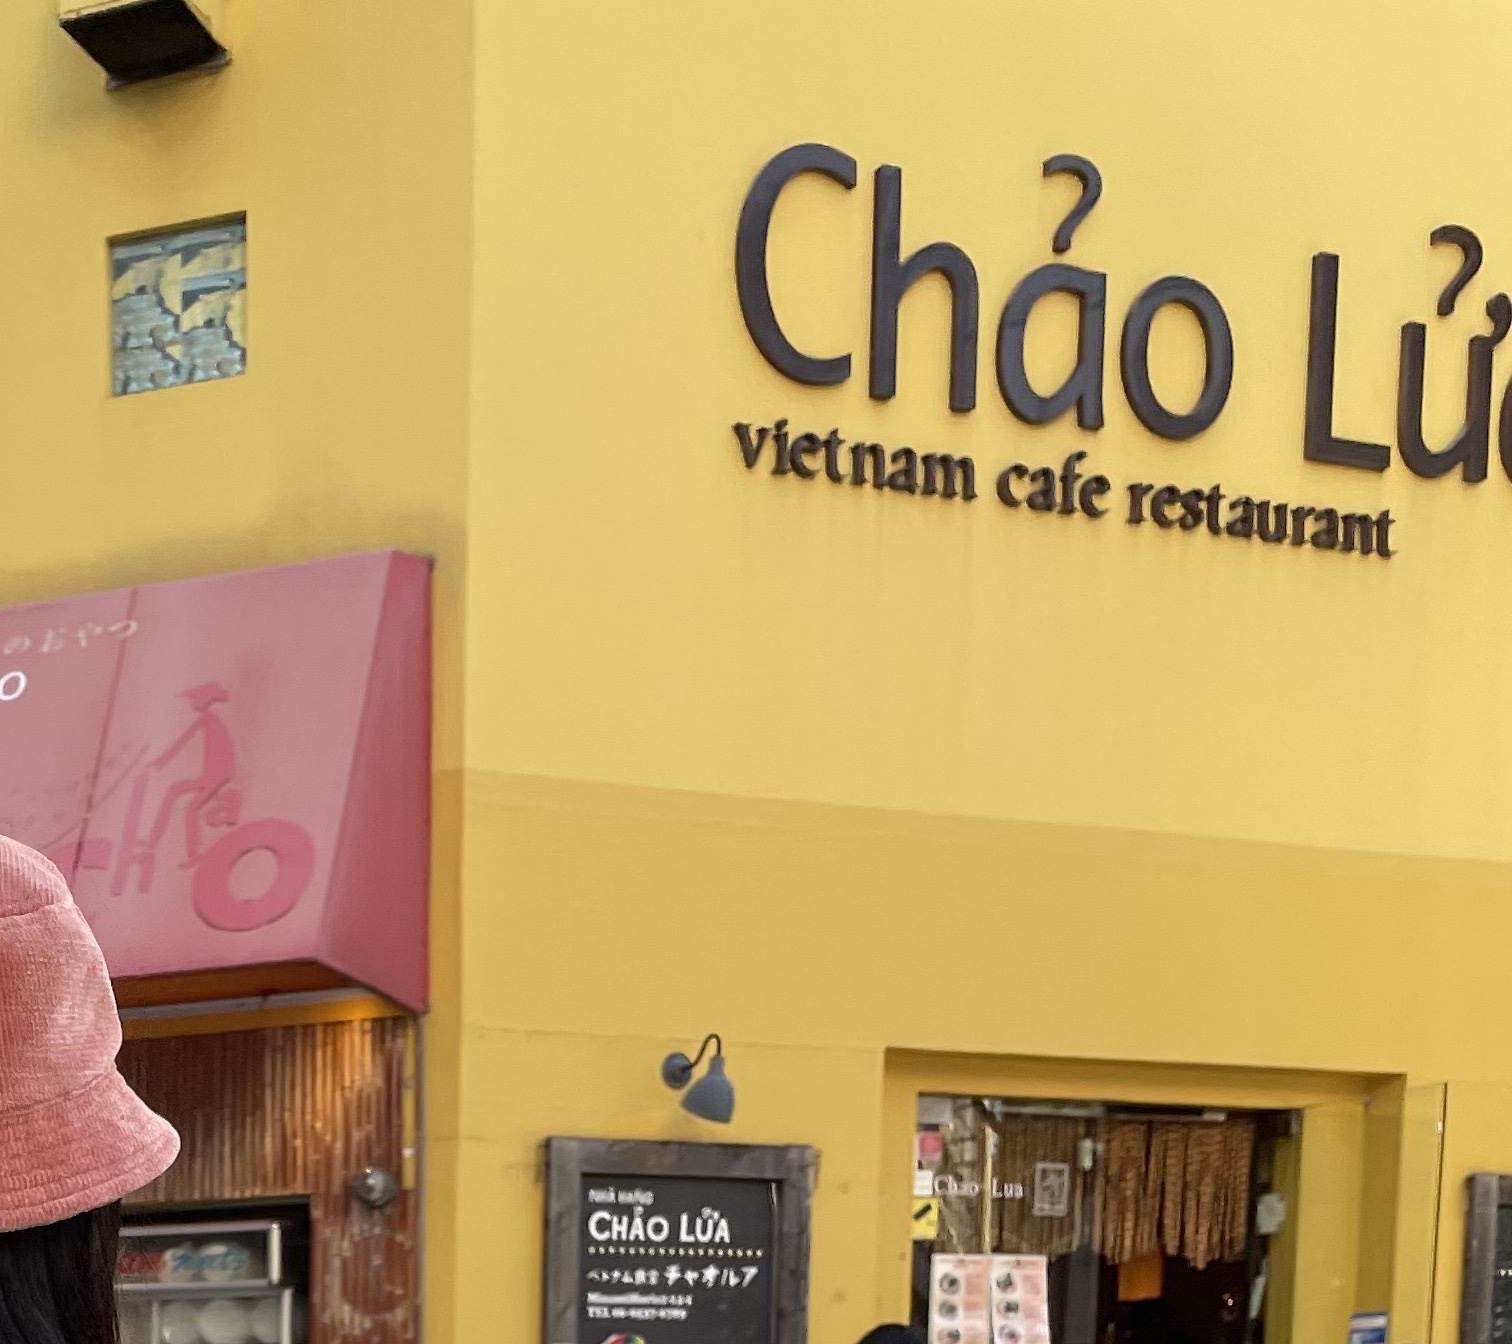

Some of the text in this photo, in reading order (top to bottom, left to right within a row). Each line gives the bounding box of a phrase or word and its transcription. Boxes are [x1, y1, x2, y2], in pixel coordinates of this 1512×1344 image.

[734, 142, 1512, 485] Chảo Lử
[732, 418, 1398, 561] vietnam cafe restaurant
